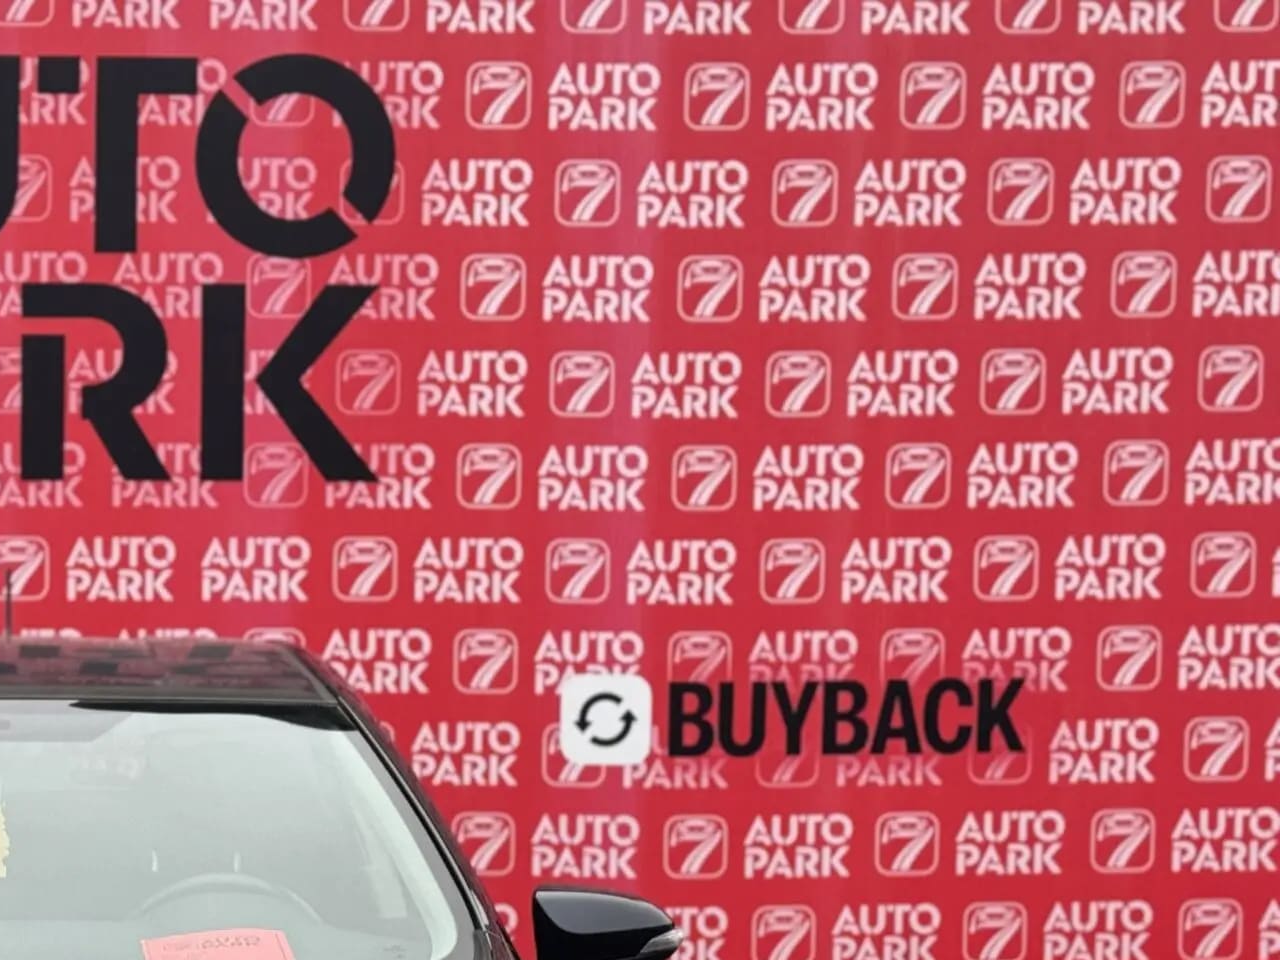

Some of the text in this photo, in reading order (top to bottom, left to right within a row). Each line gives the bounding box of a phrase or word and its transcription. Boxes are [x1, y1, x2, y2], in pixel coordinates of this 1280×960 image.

[211, 0, 316, 31] PARK
[427, 1, 534, 33] PARK
[644, 1, 750, 35] PARK
[862, 1, 969, 35] PARK
[1078, 1, 1184, 35] PARK
[548, 62, 661, 97] AUTO
[766, 62, 878, 97] AUTO
[982, 62, 1095, 96] AUTO
[548, 96, 658, 132] PARK
[766, 96, 874, 131] PARK
[982, 95, 1091, 130] PARK
[422, 159, 533, 193] AUTO
[636, 160, 749, 194] AUTO
[854, 158, 966, 193] AUTO
[1070, 157, 1182, 191] AUTO
[422, 192, 529, 227] PARK
[637, 193, 745, 229] PARK
[853, 192, 962, 227] PARK
[1069, 190, 1178, 225] PARK
[542, 254, 654, 289] AUTO
[759, 254, 871, 288] AUTO
[974, 252, 1086, 286] AUTO
[542, 288, 650, 323] PARK
[759, 287, 866, 322] PARK
[974, 285, 1082, 320] PARK
[418, 350, 528, 384] AUTO
[631, 352, 742, 385] AUTO
[847, 349, 959, 384] AUTO
[1062, 347, 1173, 381] AUTO
[418, 383, 524, 418] PARK
[631, 384, 738, 419] PARK
[847, 383, 955, 417] PARK
[1062, 380, 1169, 414] PARK
[538, 445, 649, 478] AUTO
[753, 443, 864, 478] AUTO
[967, 441, 1078, 475] AUTO
[538, 477, 645, 512] PARK
[753, 477, 860, 511] PARK
[967, 474, 1074, 508] PARK
[66, 536, 176, 569] AUTO
[201, 536, 311, 569] AUTO
[414, 537, 524, 570] AUTO
[626, 539, 736, 572] AUTO
[841, 536, 952, 570] AUTO
[1055, 533, 1166, 567] AUTO
[66, 568, 173, 602] PARK
[201, 568, 307, 602] PARK
[414, 569, 520, 603] PARK
[626, 571, 733, 605] PARK
[841, 569, 948, 603] PARK
[1055, 566, 1162, 600] PARK
[320, 628, 432, 661] AUTO
[668, 678, 1025, 758] BUYBACK
[1050, 718, 1159, 751] AUTO
[411, 721, 520, 754] AUTO
[412, 753, 517, 786] PARK
[1049, 750, 1155, 784] PARK
[531, 814, 640, 846] AUTO
[744, 813, 853, 846] AUTO
[956, 810, 1065, 843] AUTO
[1172, 807, 1280, 840] AUTO
[532, 845, 636, 879] PARK
[744, 845, 849, 879] PARK
[956, 842, 1061, 875] PARK
[1171, 839, 1277, 872] PARK
[832, 903, 941, 936] AUTO
[1044, 900, 1153, 933] AUTO
